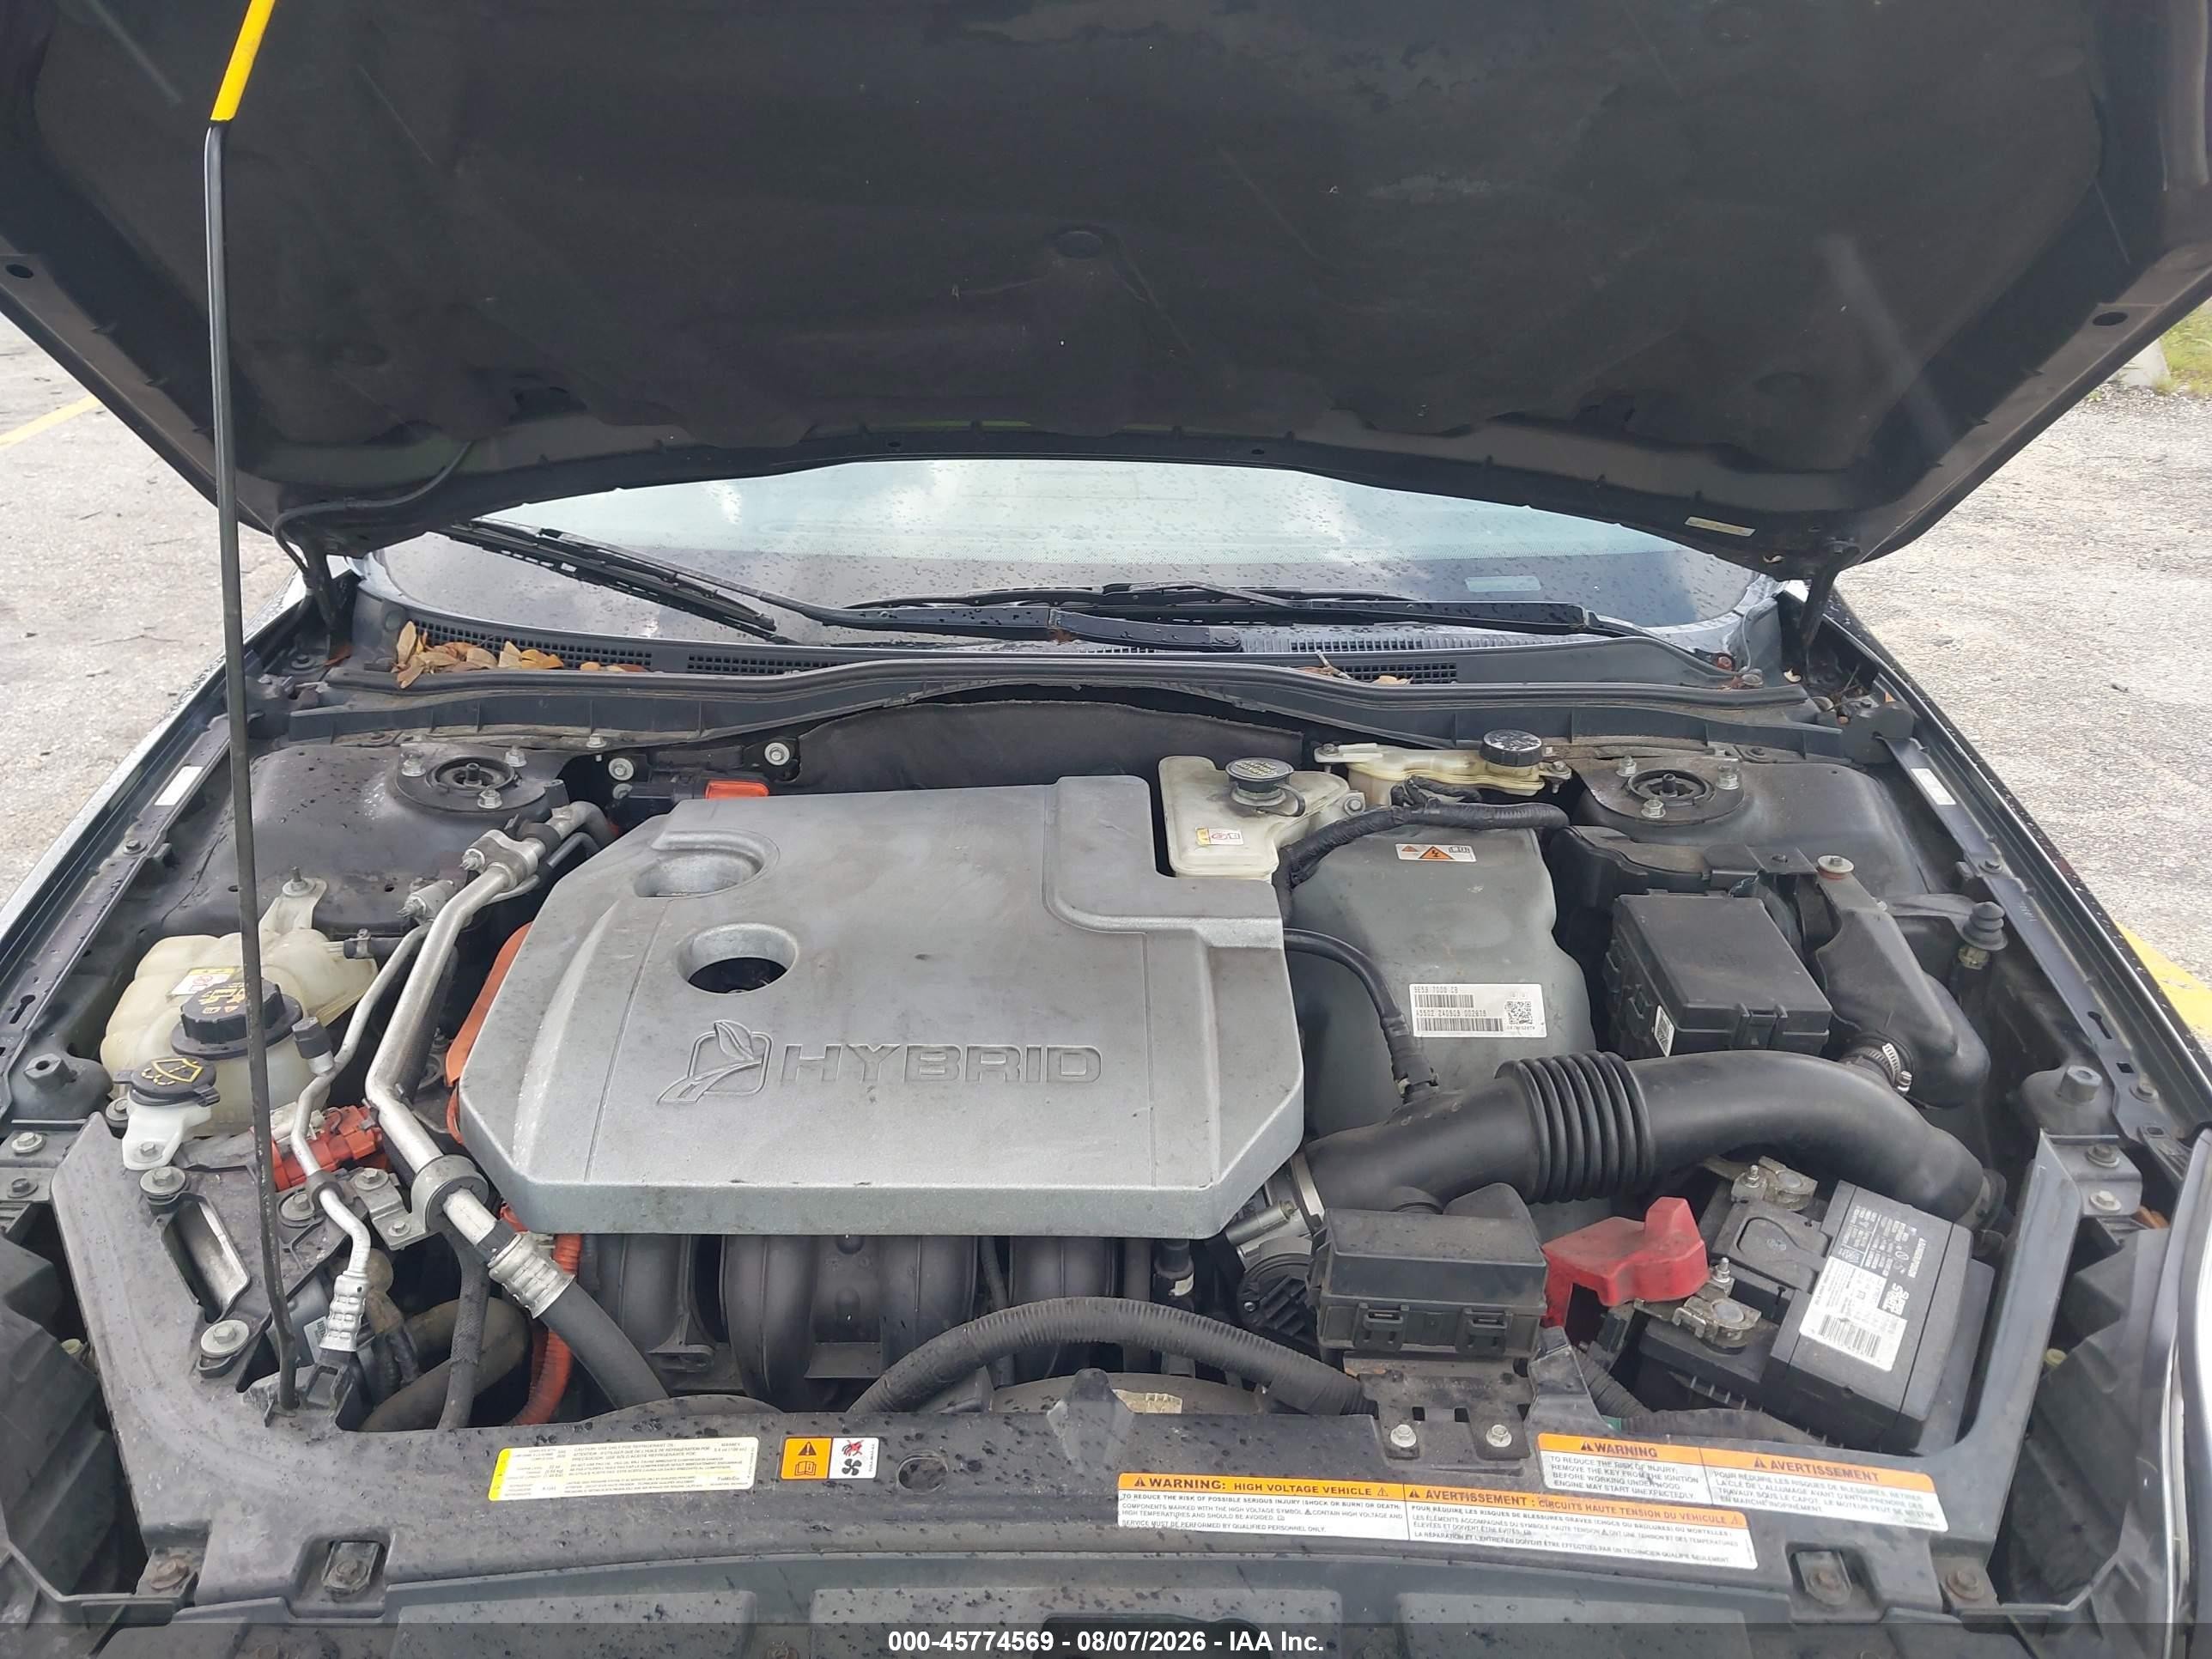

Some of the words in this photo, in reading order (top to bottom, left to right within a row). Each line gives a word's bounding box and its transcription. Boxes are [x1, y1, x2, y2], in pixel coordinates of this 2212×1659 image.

[781, 1043, 1102, 1084] HYBRID
[1595, 1443, 1657, 1457] WARNING
[1771, 1459, 1878, 1481] AVERTISSEMENT
[1149, 1478, 1225, 1489] WARNING:
[1267, 1484, 1318, 1492] VOLTAGE
[1322, 1486, 1370, 1495] VEHICLE
[1426, 1489, 1525, 1505] AVERTISSEMENT
[1539, 1499, 1582, 1510] CIRCUITS
